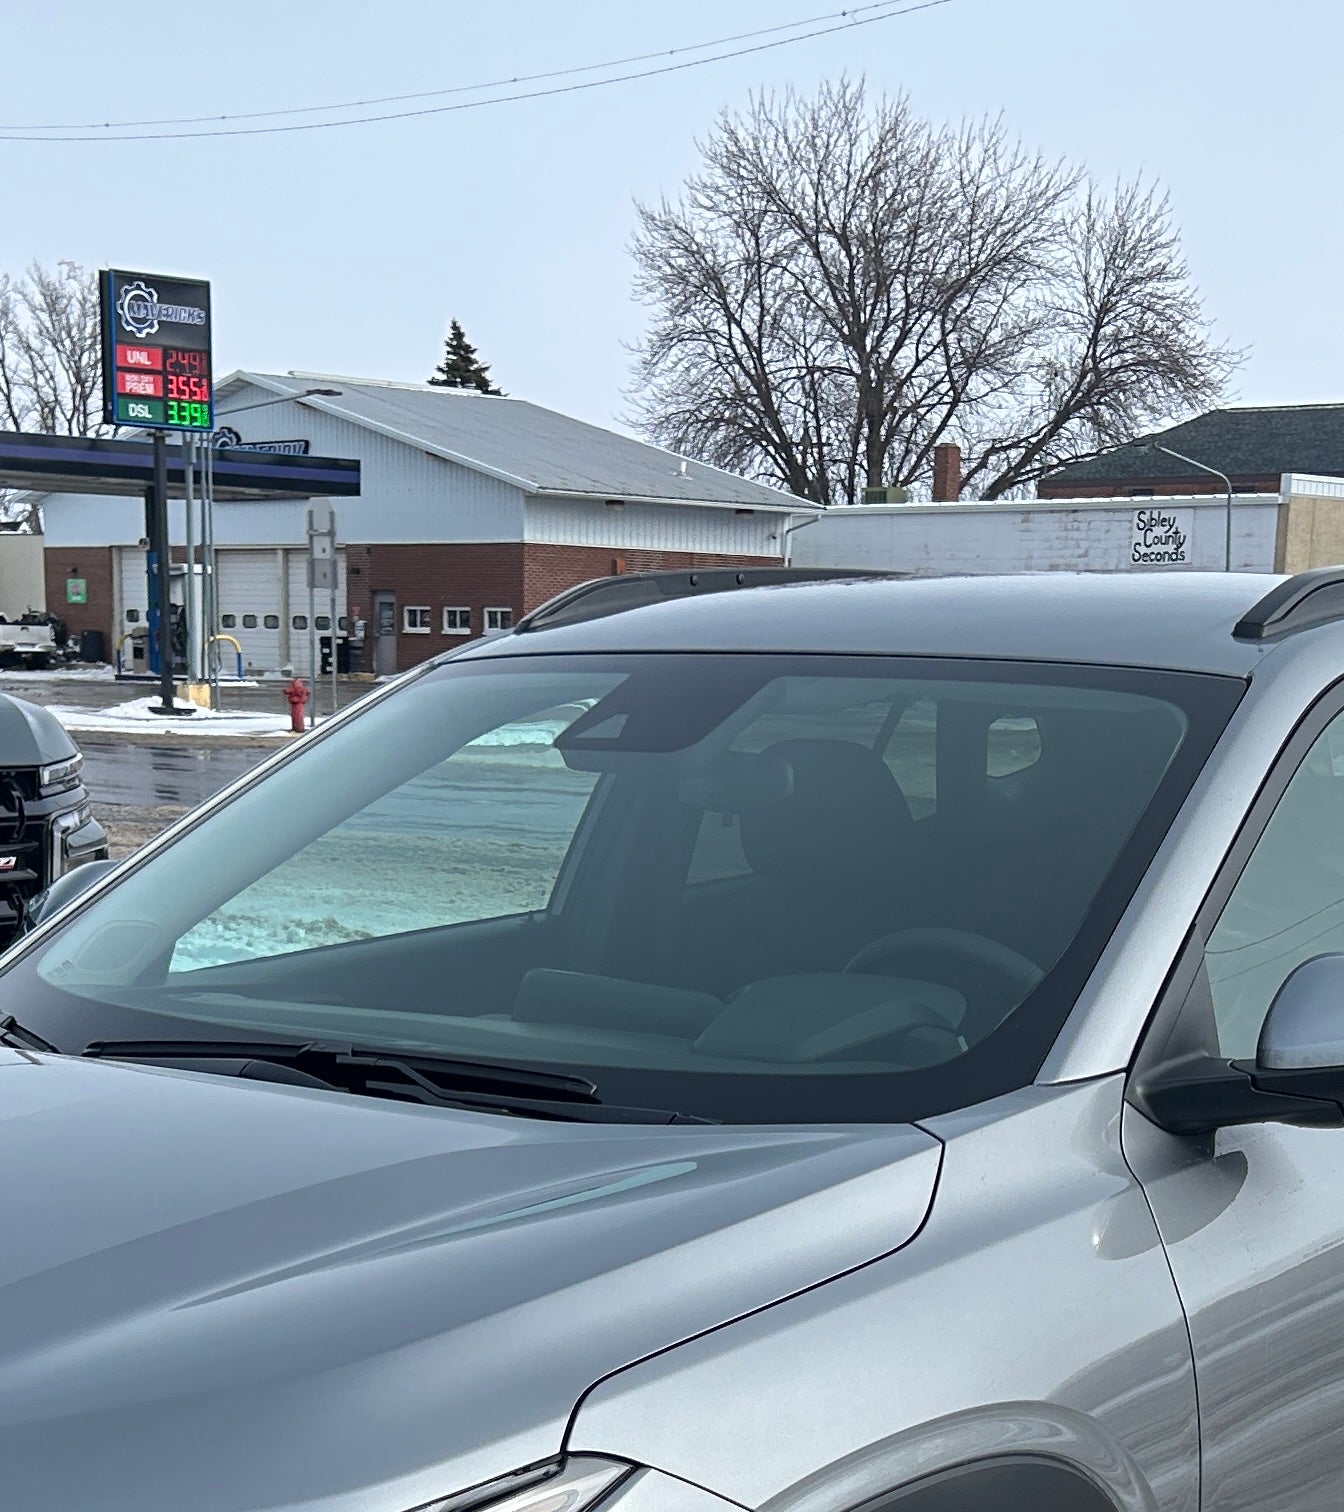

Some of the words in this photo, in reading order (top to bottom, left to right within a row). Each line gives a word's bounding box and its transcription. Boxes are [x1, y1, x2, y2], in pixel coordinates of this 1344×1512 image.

[127, 350, 152, 365] UNL
[128, 403, 153, 419] DSL
[1137, 510, 1177, 534] Sibley
[1144, 527, 1187, 550] County
[1132, 542, 1185, 562] Seconds
